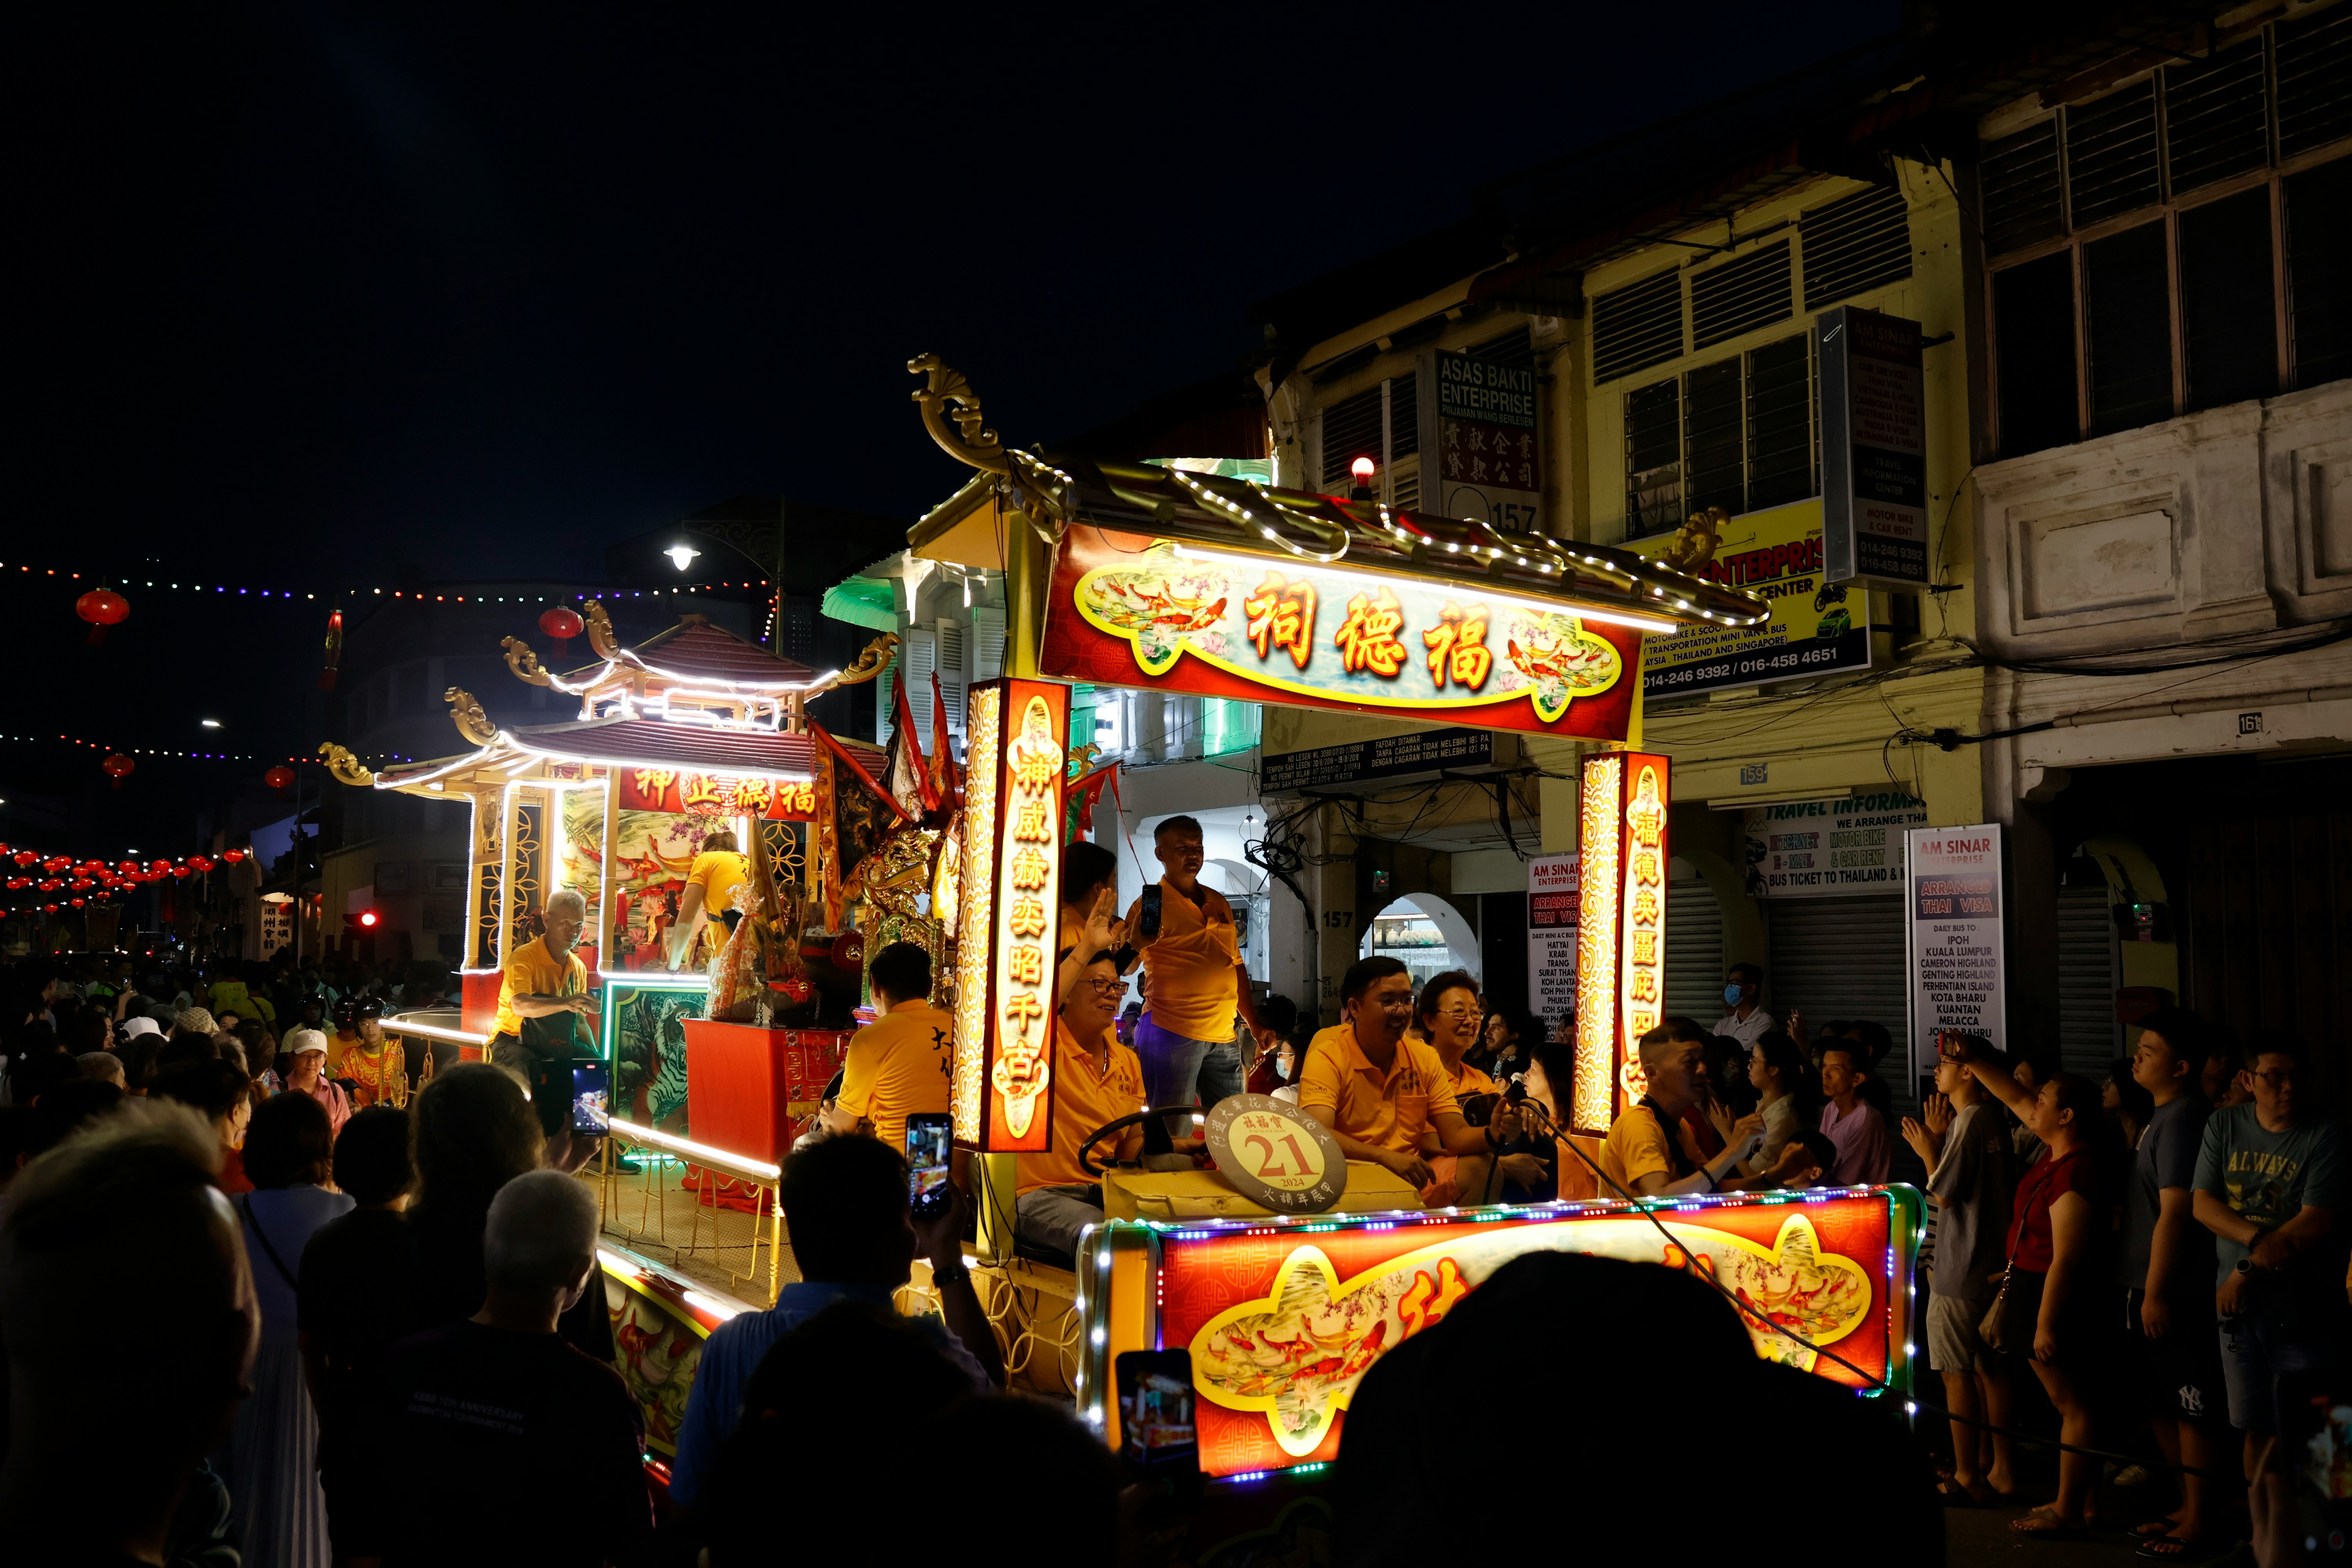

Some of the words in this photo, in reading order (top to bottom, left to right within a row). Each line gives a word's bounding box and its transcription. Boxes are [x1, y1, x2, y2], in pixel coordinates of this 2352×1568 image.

[1854, 321, 1874, 338] AM
[1878, 328, 1913, 347] SINAR
[1860, 339, 1908, 357] ENTERPRISE
[1441, 358, 1483, 385] ASAS
[1488, 365, 1532, 392] BAKTI
[1859, 362, 1874, 373] OUR
[1868, 375, 1885, 386] THAI
[1886, 379, 1904, 390] VISA
[1441, 382, 1533, 416] ENTERPRISE
[1857, 385, 1890, 399] VIETNAM
[1891, 391, 1915, 403] E-VISA
[1855, 395, 1893, 411] CAMBODIA
[1895, 403, 1918, 416] E-VISA
[1442, 405, 1476, 419] PINJAMAN
[1477, 410, 1498, 422] WANG
[1499, 414, 1534, 427] BERLESEN
[1855, 407, 1893, 422] AUSTRALIA
[1895, 414, 1918, 426] E-VISA
[1864, 419, 1885, 432] INDIA
[1887, 424, 1910, 436] E-VISA
[1856, 430, 1894, 444] MYANMAR
[1896, 436, 1918, 448] E-VISA
[1448, 452, 1532, 488] 貸款公司
[1876, 457, 1902, 470] TRAVEL
[1861, 468, 1916, 486] INFORMATION
[1875, 484, 1904, 497] CENTER
[1493, 502, 1537, 535] 157
[1867, 508, 1895, 523] MOTOR
[1898, 513, 1914, 524] BIKE
[1869, 522, 1875, 531] &
[1876, 523, 1892, 535] CAR
[1894, 525, 1912, 536] RENT
[1860, 541, 1898, 558] 014-246
[1900, 548, 1923, 561] 9392
[1861, 557, 1899, 572] 016-458
[1900, 563, 1923, 575] 4651
[1757, 578, 1814, 599] CENTER
[1644, 629, 1689, 645] MOTORBIKE
[1649, 635, 1717, 655] TRANSPORTATION
[1720, 632, 1740, 643] MINI
[1742, 629, 1760, 639] VAN
[1771, 624, 1787, 634] BUS
[1673, 650, 1713, 662] THAILAND
[1715, 645, 1733, 655] AND
[1736, 635, 1788, 652] SINGAPORE)
[1643, 670, 1694, 689] 014-246
[1696, 664, 1730, 680] 9392
[1740, 653, 1798, 674] 016-458
[1801, 647, 1837, 664] 4651
[1376, 748, 1392, 758] TANPA
[1422, 742, 1439, 750] TIDAK
[1441, 737, 1466, 748] MELEBIHI
[1287, 755, 1294, 763] NO
[1372, 757, 1392, 768] DENGAN
[1422, 751, 1439, 760] TIDAK
[1440, 746, 1466, 758] MELEBIHI
[1266, 764, 1284, 774] TEMPOH
[1285, 763, 1294, 771] SAH
[1279, 771, 1294, 780] PERMIT
[1743, 766, 1764, 784] 159
[1262, 783, 1280, 791] TEMPOH
[1765, 801, 1826, 820] TRAVEL
[1837, 819, 1852, 829] WE
[1855, 814, 1904, 828] ARRANGE
[1907, 812, 1927, 823] THA
[1769, 832, 1819, 851] INTERNET
[1829, 830, 1863, 848] MOTOR
[1863, 829, 1886, 846] BIKE
[1920, 841, 1942, 855] AM
[1947, 838, 1991, 854] SINAR
[1789, 853, 1815, 869] MAIL
[1831, 851, 1838, 868] &
[1840, 850, 1861, 867] CAR
[1860, 848, 1886, 866] RENT
[1534, 865, 1549, 877] AM
[1769, 874, 1787, 886] BUS
[1789, 871, 1822, 886] TICKET
[1824, 871, 1837, 884] TO
[1839, 868, 1887, 884] THAILAND
[1890, 867, 1897, 880] &
[1538, 876, 1577, 886] ENTERPRISE
[1921, 879, 1992, 896] ARRANGED
[1921, 898, 1952, 914] THAI
[1960, 897, 1993, 913] VISA
[1323, 911, 1353, 928] 157
[1534, 911, 1555, 924] THAI
[264, 907, 276, 949] 潮州會館
[1947, 935, 1969, 945] IPOH
[1926, 947, 1955, 957] KUALA
[1957, 947, 1992, 956] LUMPUR
[1547, 959, 1570, 967] TRANG
[1920, 959, 1956, 968] CAMERON
[1957, 958, 1996, 967] HIGHLAND
[1922, 970, 1955, 979] GENTING
[1956, 970, 1995, 979] HIGHLAND
[1923, 982, 1966, 991] PERHENTIAN
[1968, 982, 1995, 991] ISLAND
[1931, 993, 1954, 1002] KOTA
[1956, 993, 1986, 1002] BHARU
[1936, 1004, 1981, 1014] KUANTAN
[1939, 1016, 1979, 1025] MELACCA
[1961, 1028, 1992, 1038] BAHRU
[1245, 1133, 1321, 1178] 21
[2227, 1150, 2298, 1181] ALWAYS
[1280, 1178, 1305, 1187] 2024
